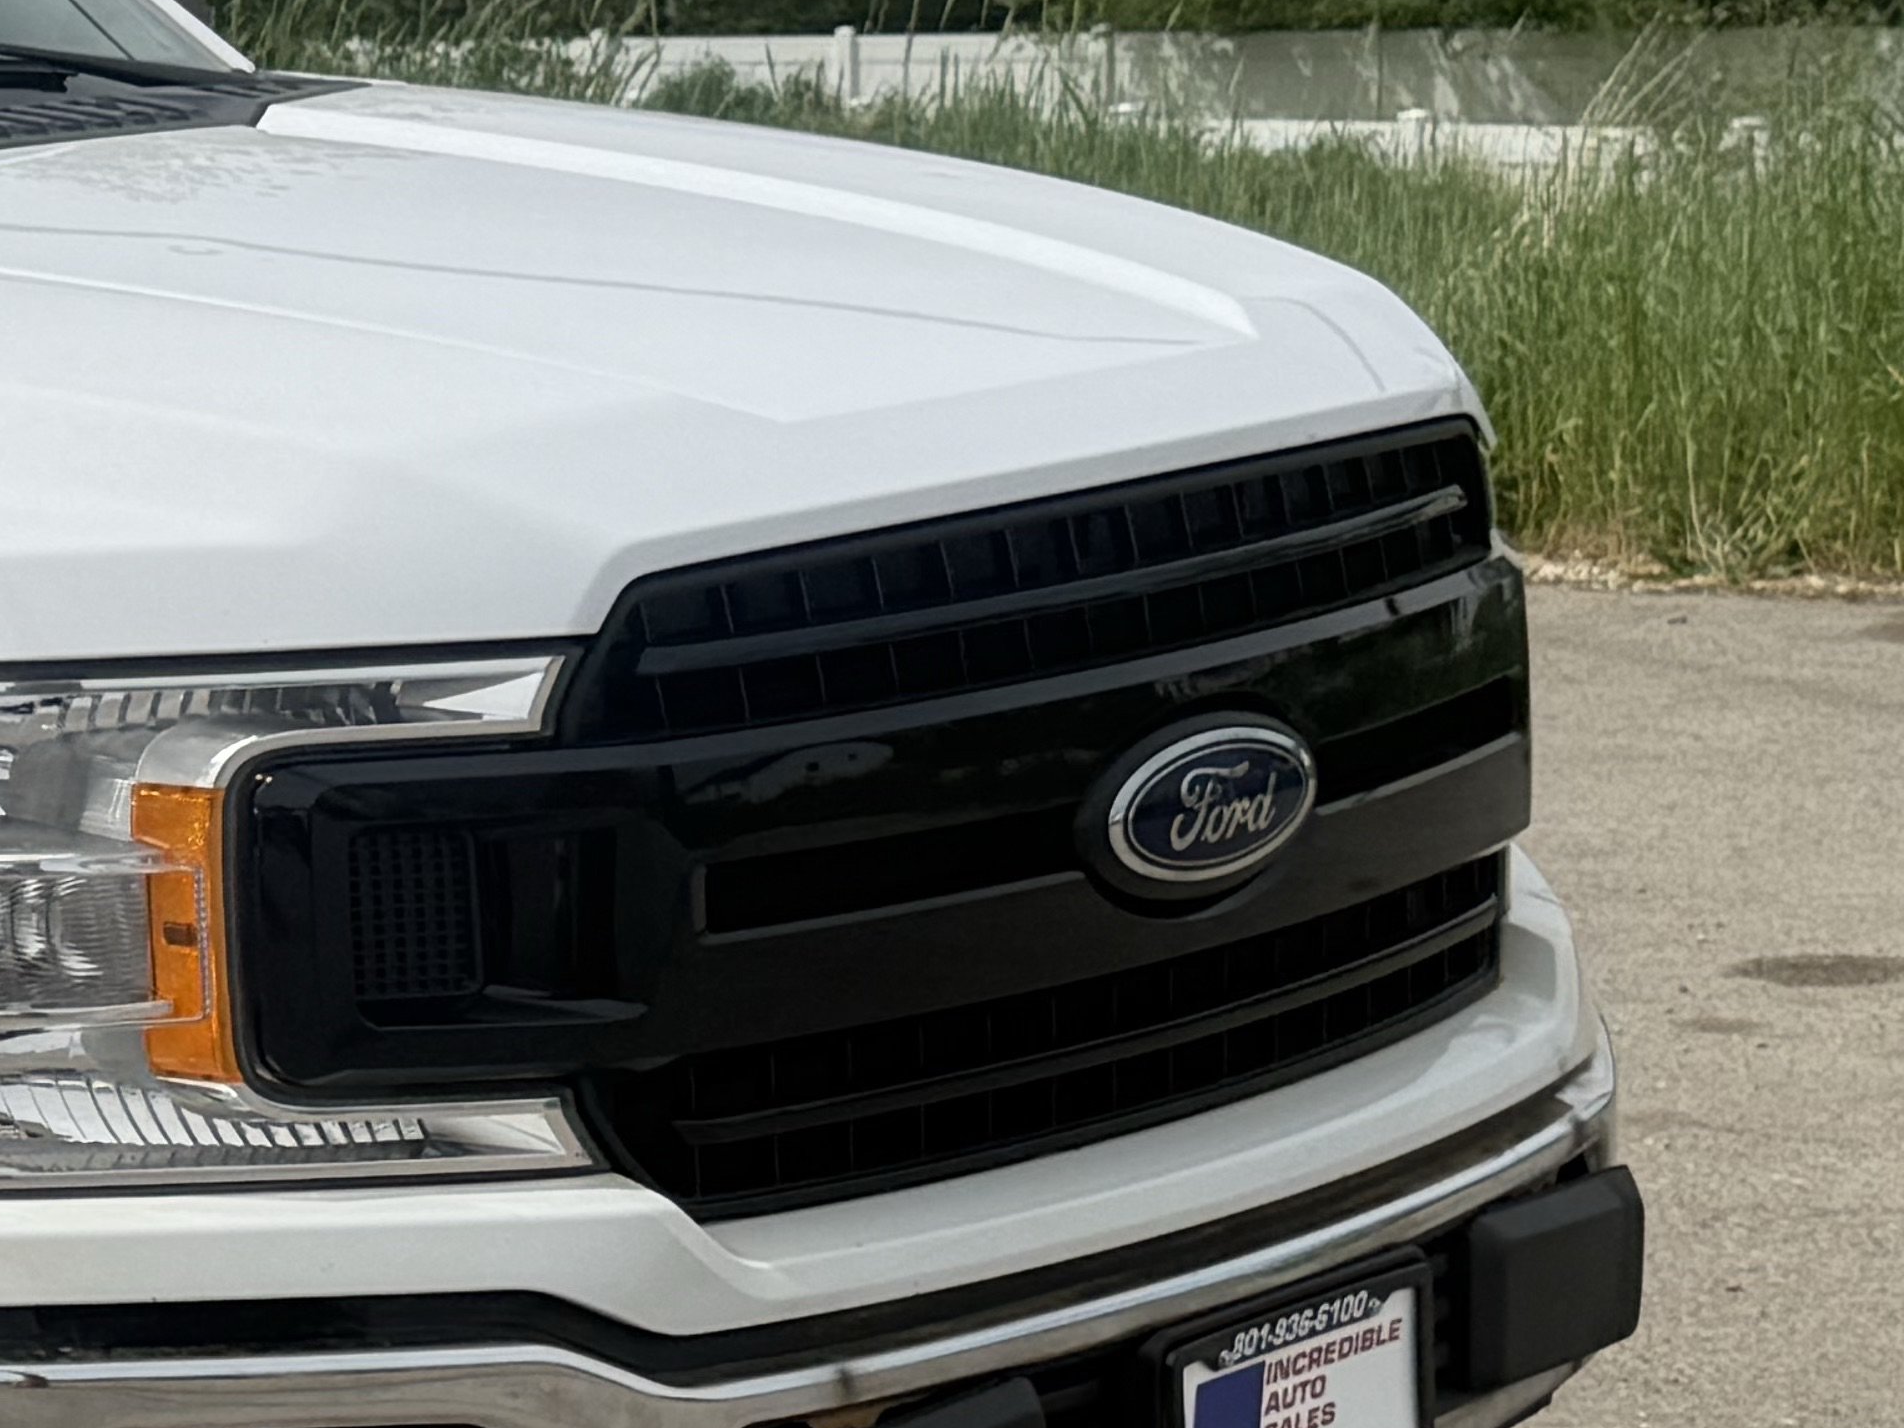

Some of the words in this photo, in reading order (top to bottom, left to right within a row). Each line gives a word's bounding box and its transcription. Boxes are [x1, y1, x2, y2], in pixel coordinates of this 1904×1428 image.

[1170, 761, 1278, 851] Ford
[1265, 1317, 1403, 1386] INCREDIBLE
[1263, 1374, 1327, 1417] AUTO
